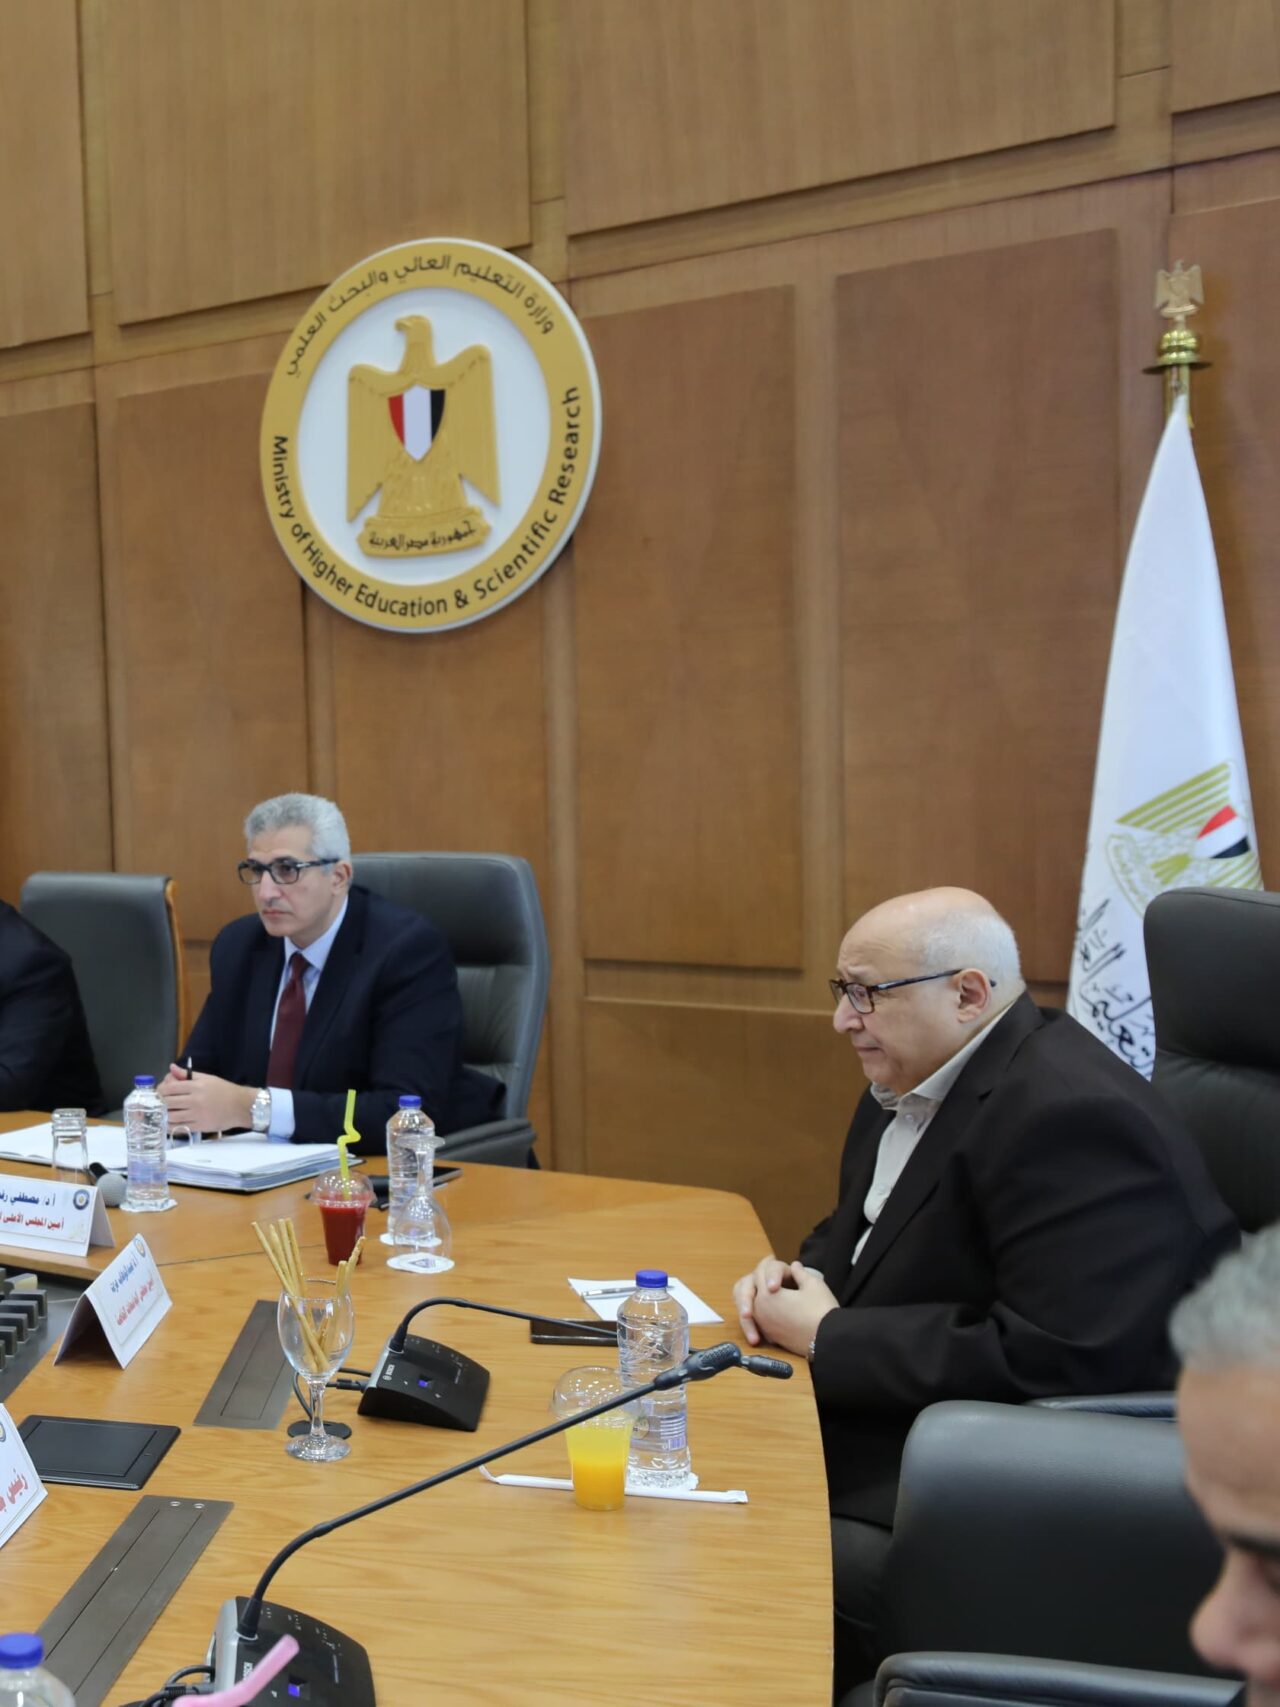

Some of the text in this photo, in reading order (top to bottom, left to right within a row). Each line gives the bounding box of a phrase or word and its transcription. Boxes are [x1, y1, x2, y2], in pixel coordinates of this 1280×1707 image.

[286, 254, 555, 377] وزارة التعليم العالي والبحث العلمي
[272, 386, 581, 618] Ministry of Higher Education & Scientific Research
[25, 1214, 47, 1228] المجلس
[47, 1216, 65, 1231] أمين
[6, 1467, 29, 1505] رئيس
